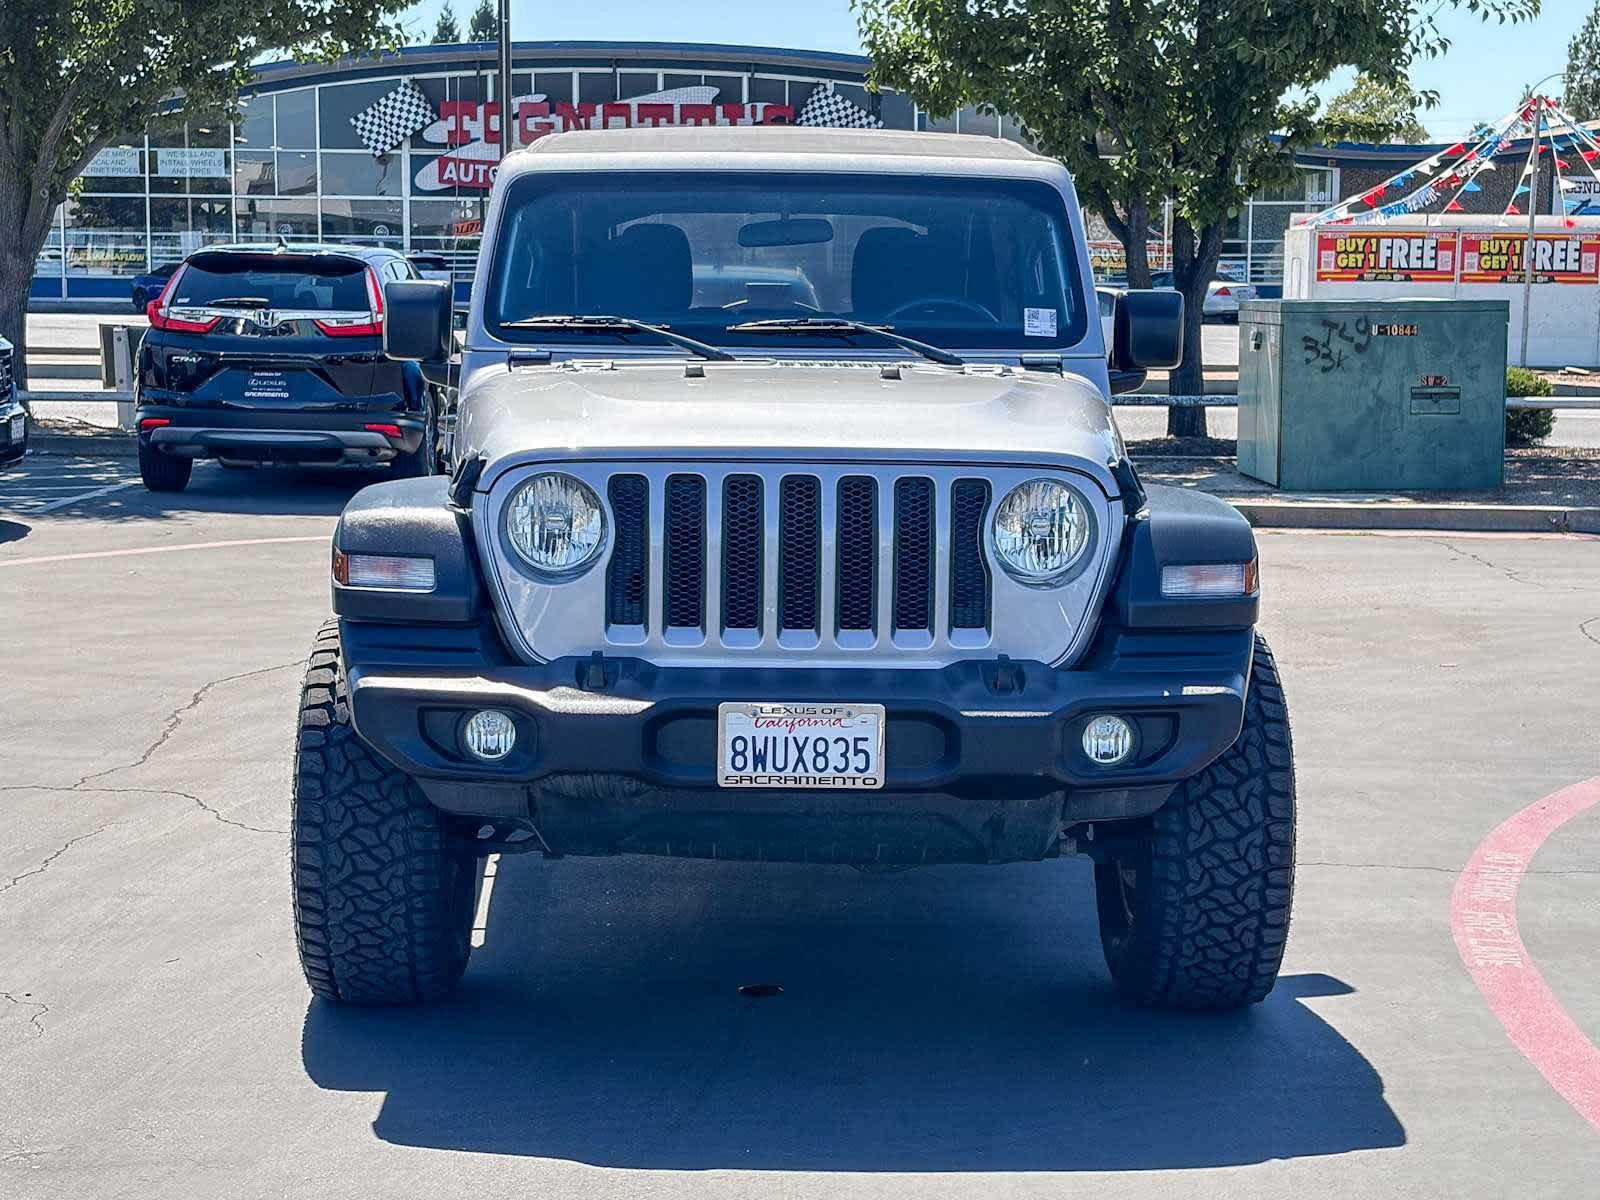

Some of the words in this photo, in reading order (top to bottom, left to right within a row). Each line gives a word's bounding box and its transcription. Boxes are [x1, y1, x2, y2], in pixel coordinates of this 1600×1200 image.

[160, 159, 187, 167] INSTALL
[190, 159, 223, 167] WHEELS
[111, 167, 139, 175] PRICES
[1336, 238, 1366, 253] BUY
[1371, 238, 1377, 252] 1
[1479, 239, 1509, 254] BUY
[1514, 239, 1520, 254] 1
[1336, 253, 1365, 268] GET
[1369, 254, 1375, 268] 1
[1379, 238, 1438, 270] FREE
[1523, 240, 1581, 271] FREE
[1480, 254, 1508, 270] GET
[1512, 255, 1518, 270] 1
[1371, 323, 1418, 336] U-10844
[759, 706, 818, 715] LEXUS
[825, 707, 845, 715] OF
[754, 716, 853, 734] California
[730, 735, 871, 774] 8WUX835
[724, 775, 878, 786] SACRAMENTO
